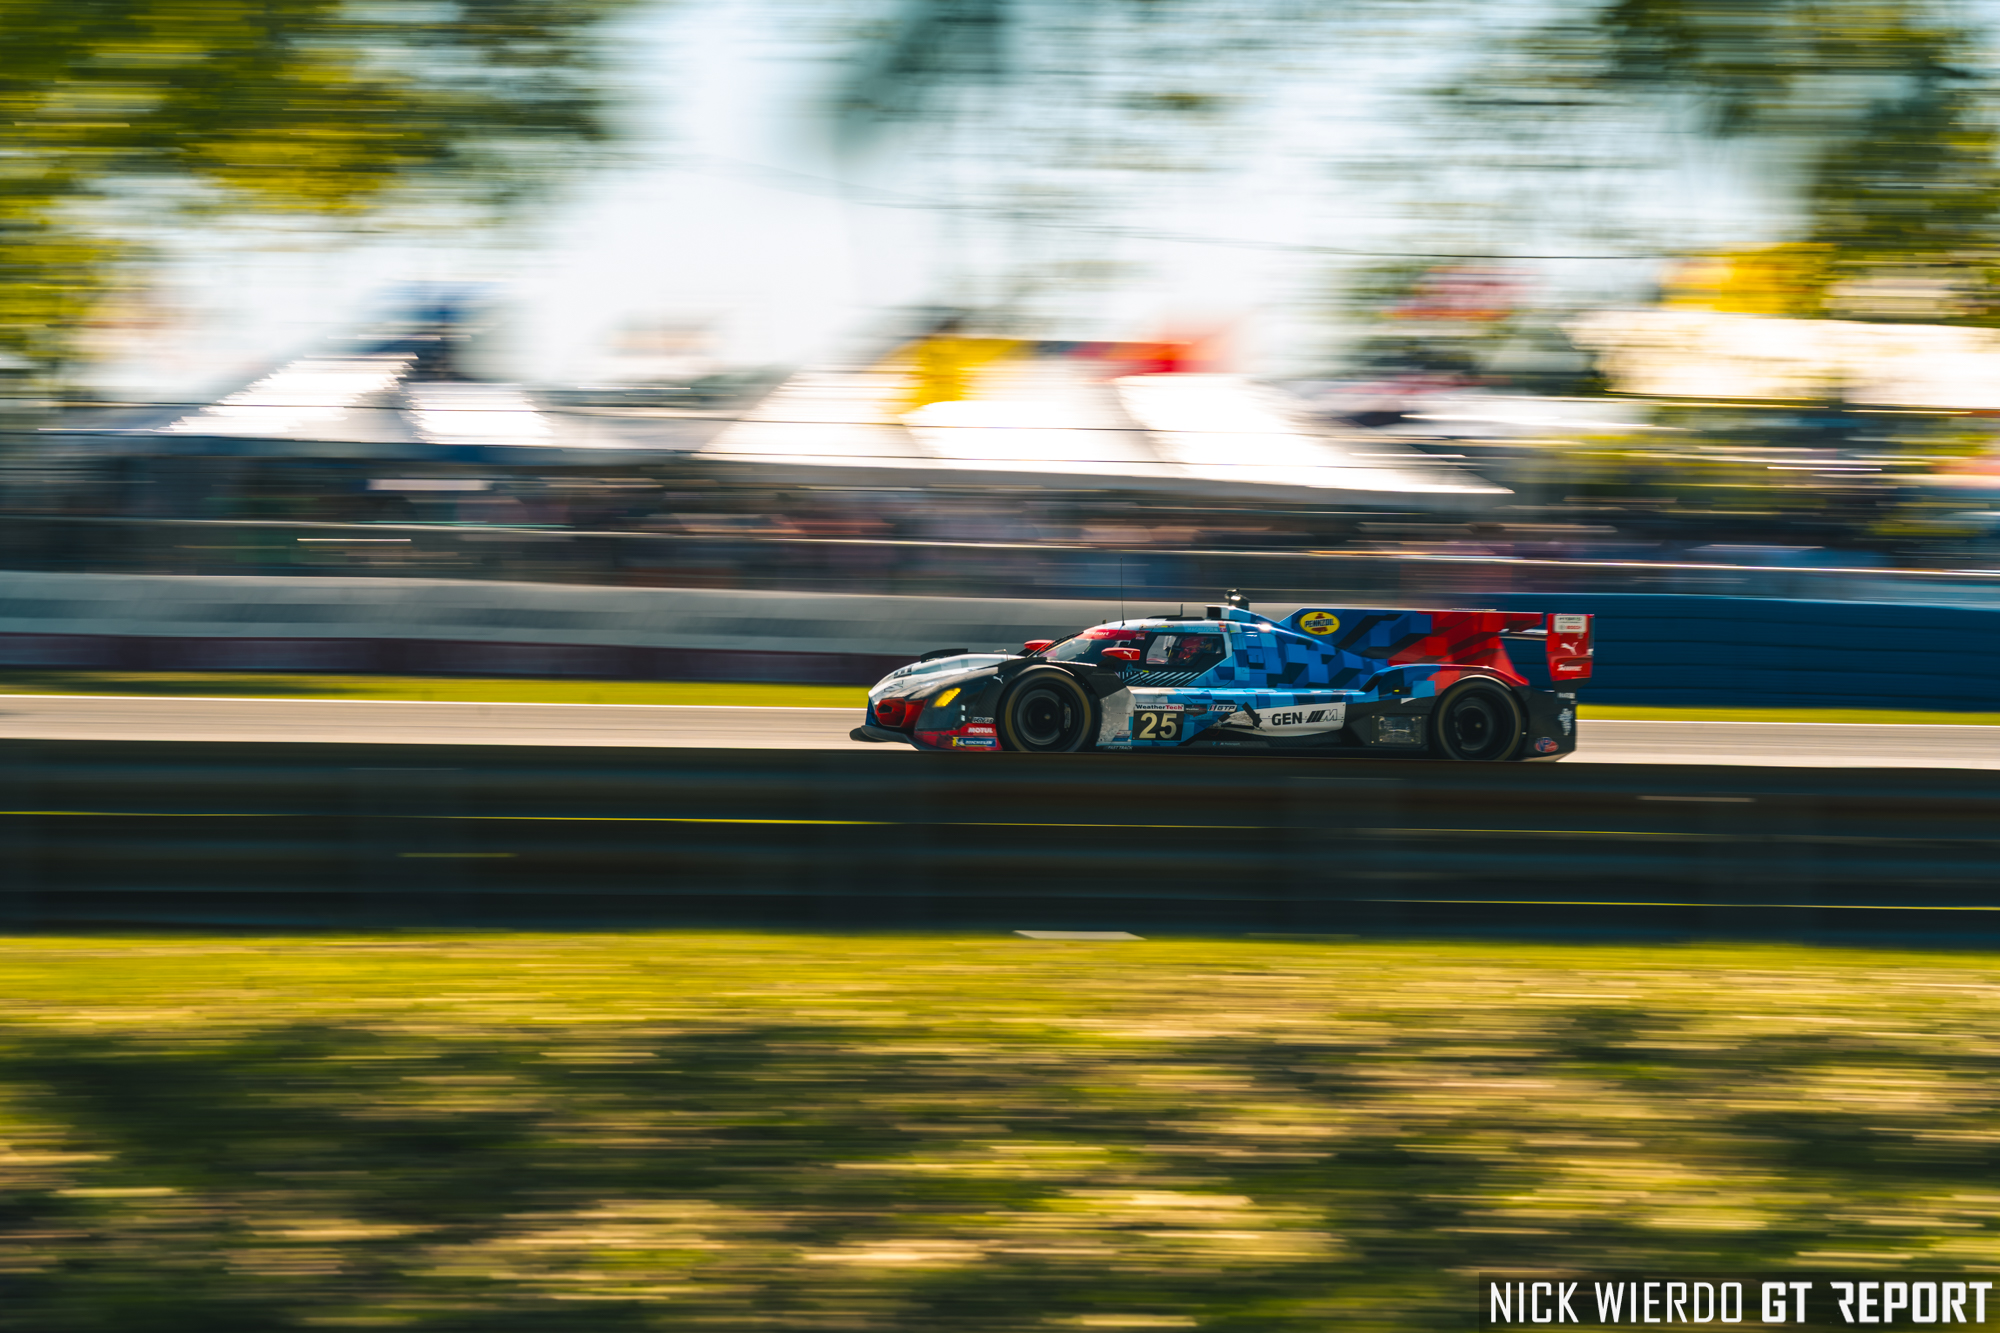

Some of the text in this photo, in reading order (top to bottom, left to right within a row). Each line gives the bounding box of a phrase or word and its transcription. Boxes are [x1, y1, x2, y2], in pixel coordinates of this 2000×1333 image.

[1305, 618, 1335, 628] PENNZOIL
[1139, 712, 1177, 739] 25
[1271, 712, 1303, 726] GEN
